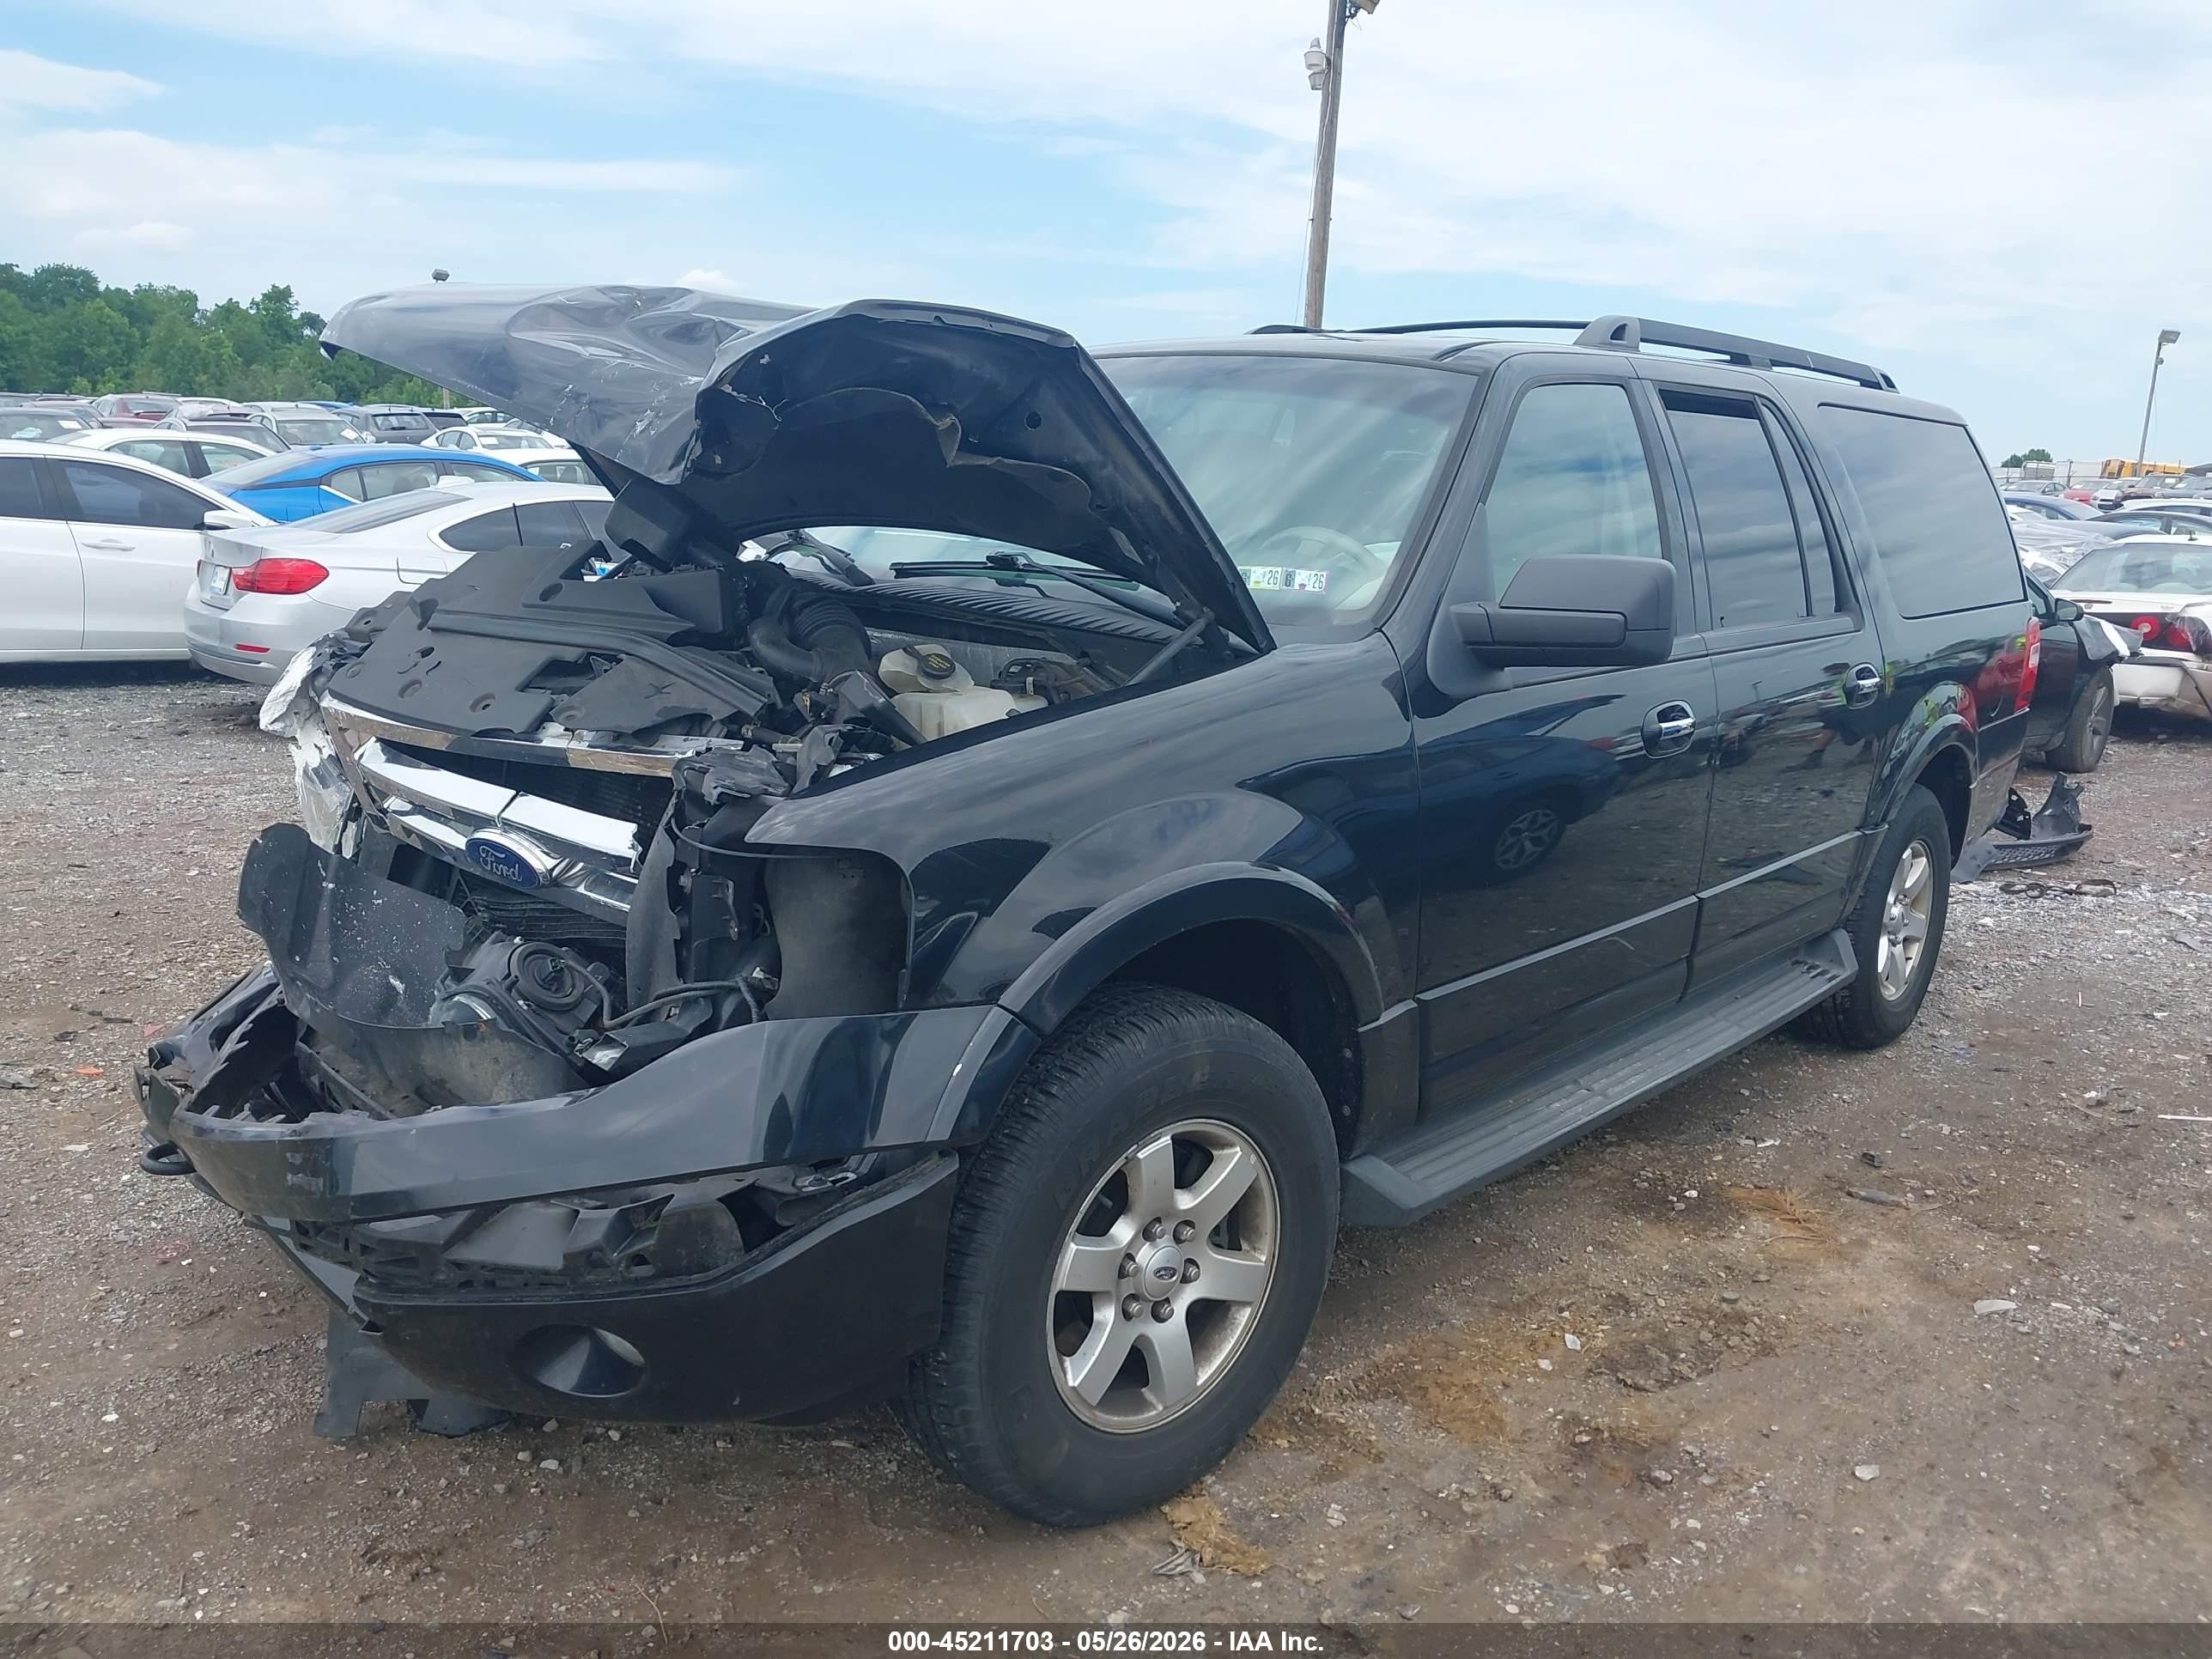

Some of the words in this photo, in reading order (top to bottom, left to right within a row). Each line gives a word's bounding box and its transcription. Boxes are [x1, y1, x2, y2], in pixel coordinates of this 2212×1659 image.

[1267, 569, 1279, 586] 26
[1312, 573, 1324, 590] 26
[479, 845, 522, 882] Ford
